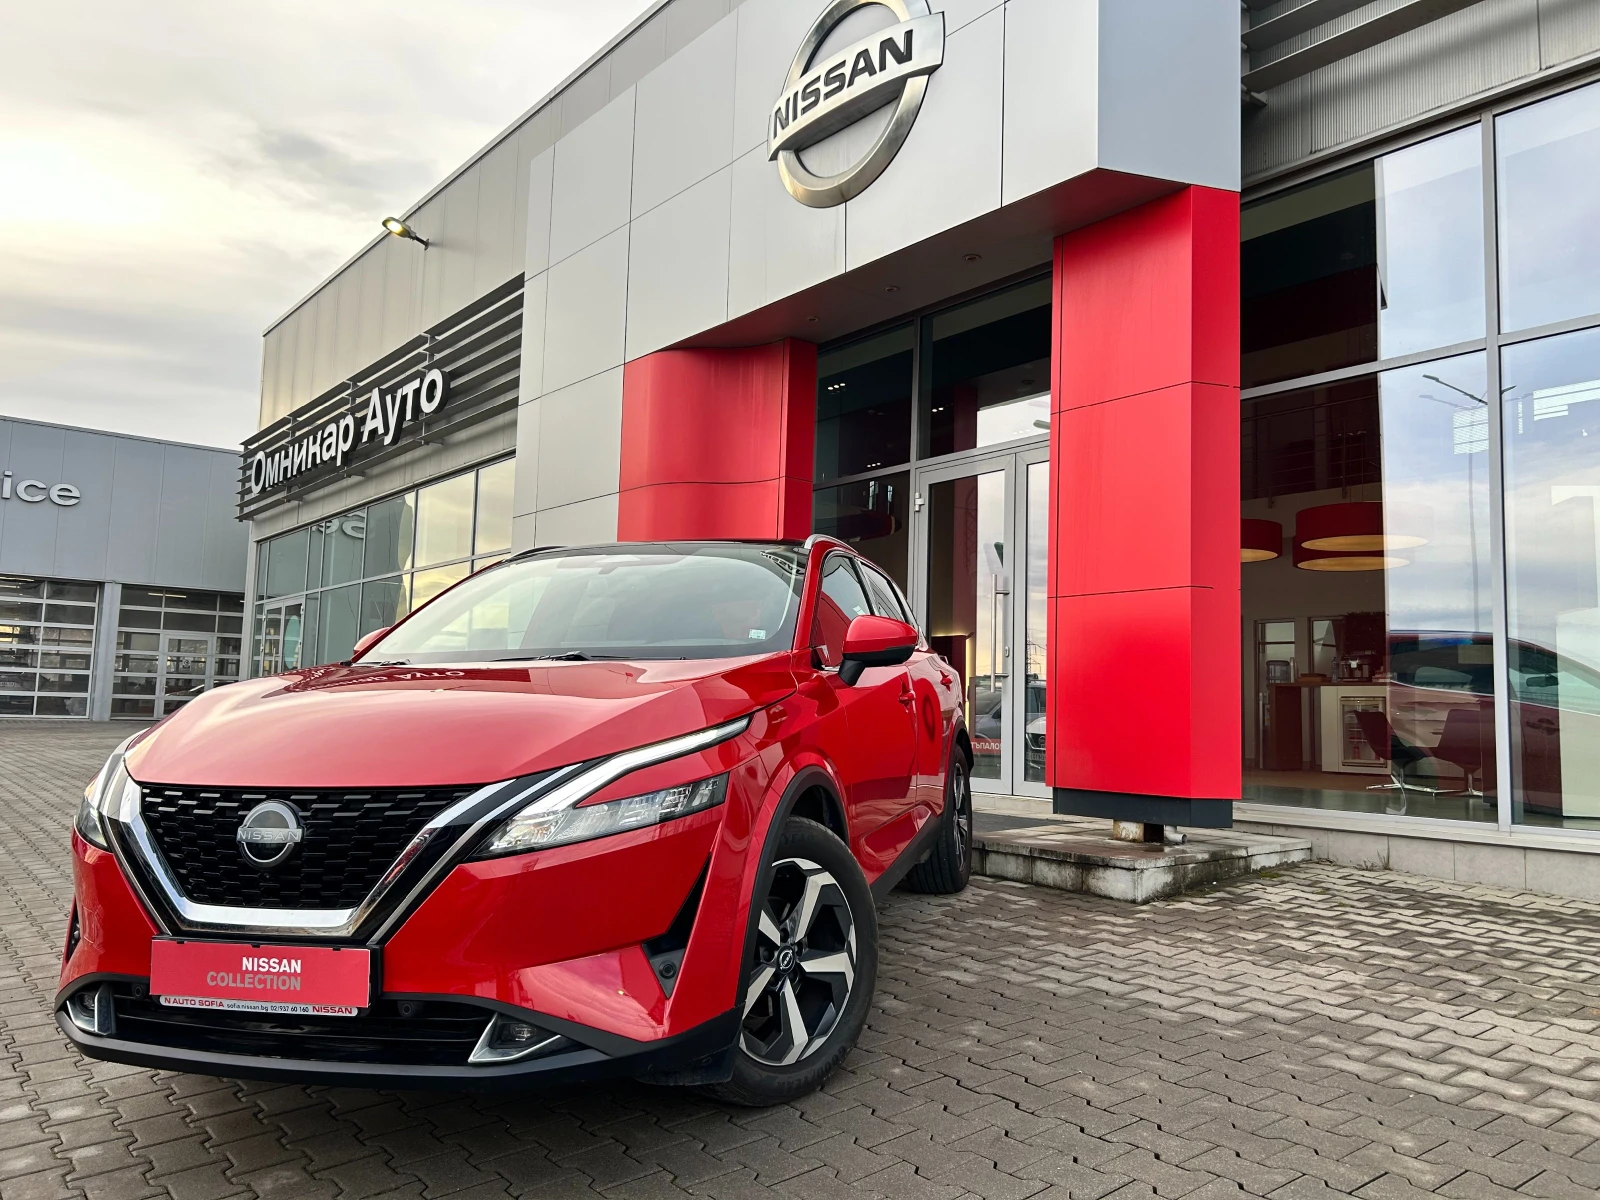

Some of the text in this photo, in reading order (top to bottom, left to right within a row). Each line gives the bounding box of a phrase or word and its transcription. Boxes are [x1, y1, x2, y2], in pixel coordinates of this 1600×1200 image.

[773, 29, 914, 140] NISSAN
[251, 368, 444, 494] Омникар Ауто
[2, 470, 81, 506] ice
[237, 831, 299, 841] NISSAN
[242, 956, 301, 973] NISSAN
[206, 971, 300, 990] COLLECTION
[172, 998, 196, 1006] AUTO
[198, 1000, 224, 1008] SOFIA
[312, 1005, 352, 1014] NISSAN
